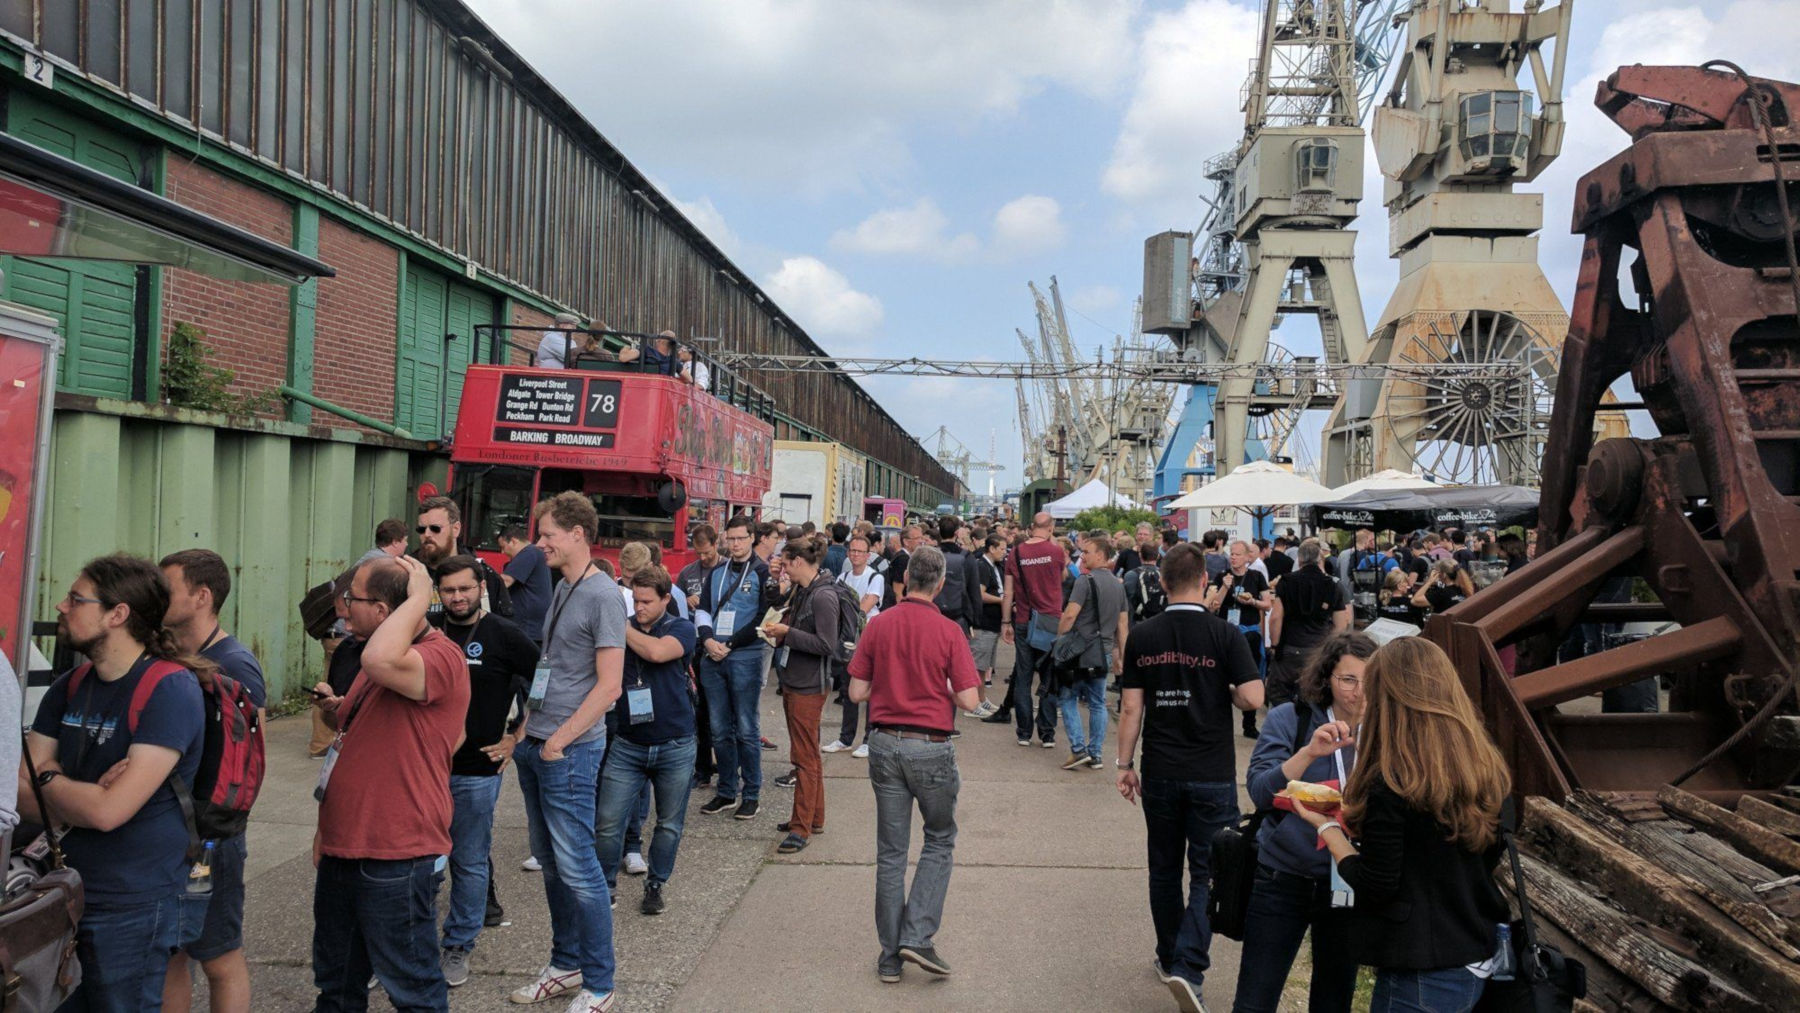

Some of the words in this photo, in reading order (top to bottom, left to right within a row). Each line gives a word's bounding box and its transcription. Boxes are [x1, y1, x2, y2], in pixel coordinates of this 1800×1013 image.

[33, 58, 43, 81] 2
[519, 378, 548, 390] Liverpool
[548, 380, 567, 389] Street
[507, 389, 531, 399] Aldgate
[535, 390, 554, 400] Tower
[554, 391, 575, 402] Bridge
[506, 400, 529, 411] Grange
[529, 401, 538, 410] Rd
[542, 402, 564, 412] Dunton
[564, 403, 574, 412] Rd
[590, 393, 615, 414] 78
[506, 411, 535, 421] Peckham
[538, 412, 554, 422] Park
[554, 414, 571, 423] Road
[510, 430, 549, 443] BARKING
[555, 433, 603, 446] BROADWAY
[479, 448, 530, 461] Londoner
[1437, 511, 1478, 521] coffee-bike
[1020, 556, 1052, 566] RGANIZER
